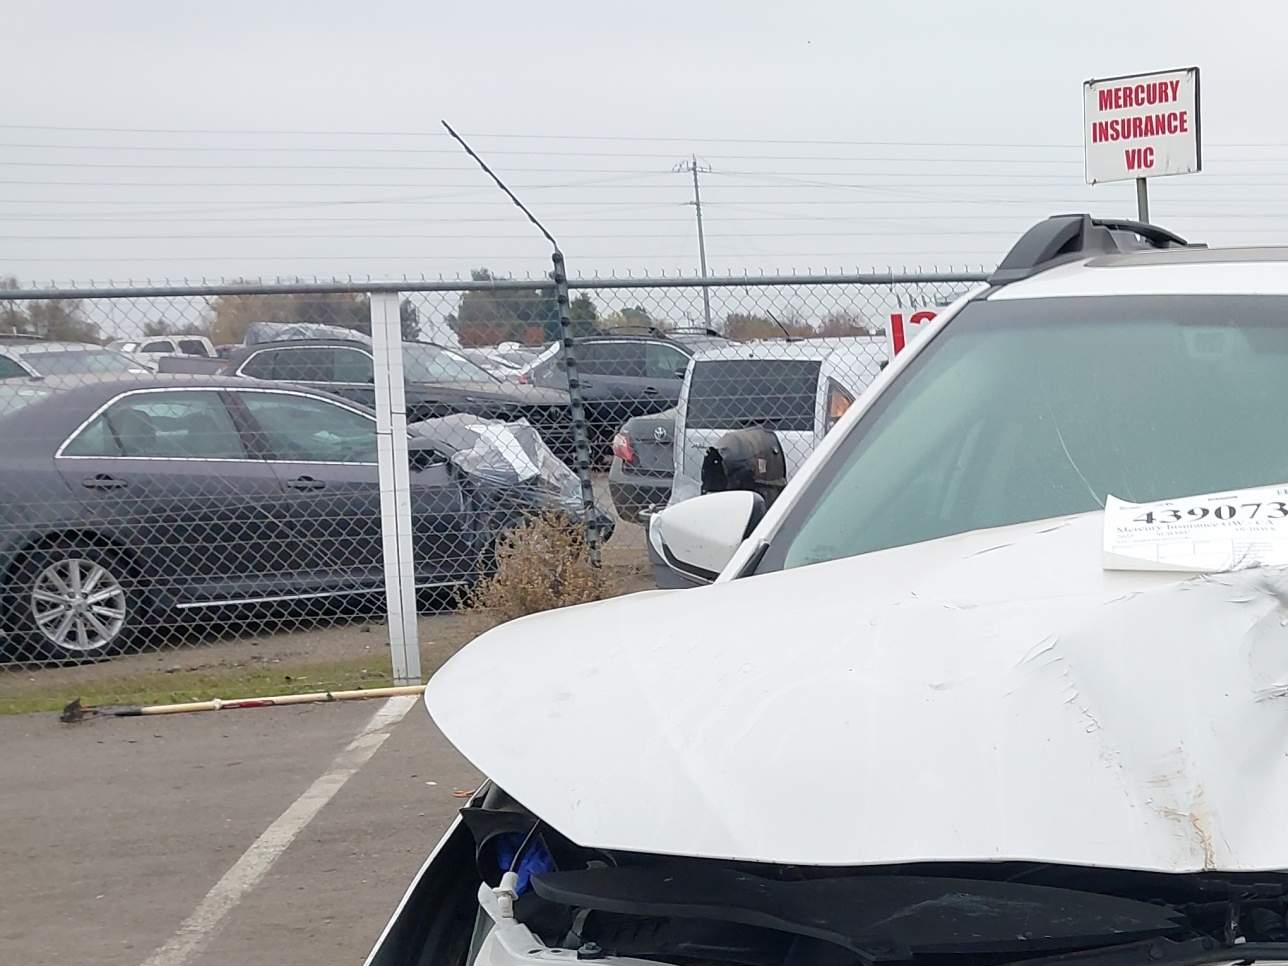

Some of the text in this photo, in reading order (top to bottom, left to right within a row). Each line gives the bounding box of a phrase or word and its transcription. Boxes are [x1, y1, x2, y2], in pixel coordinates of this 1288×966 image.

[1098, 80, 1180, 111] MERCURY
[1092, 111, 1188, 143] INSURANCE
[1125, 147, 1154, 170] VIC
